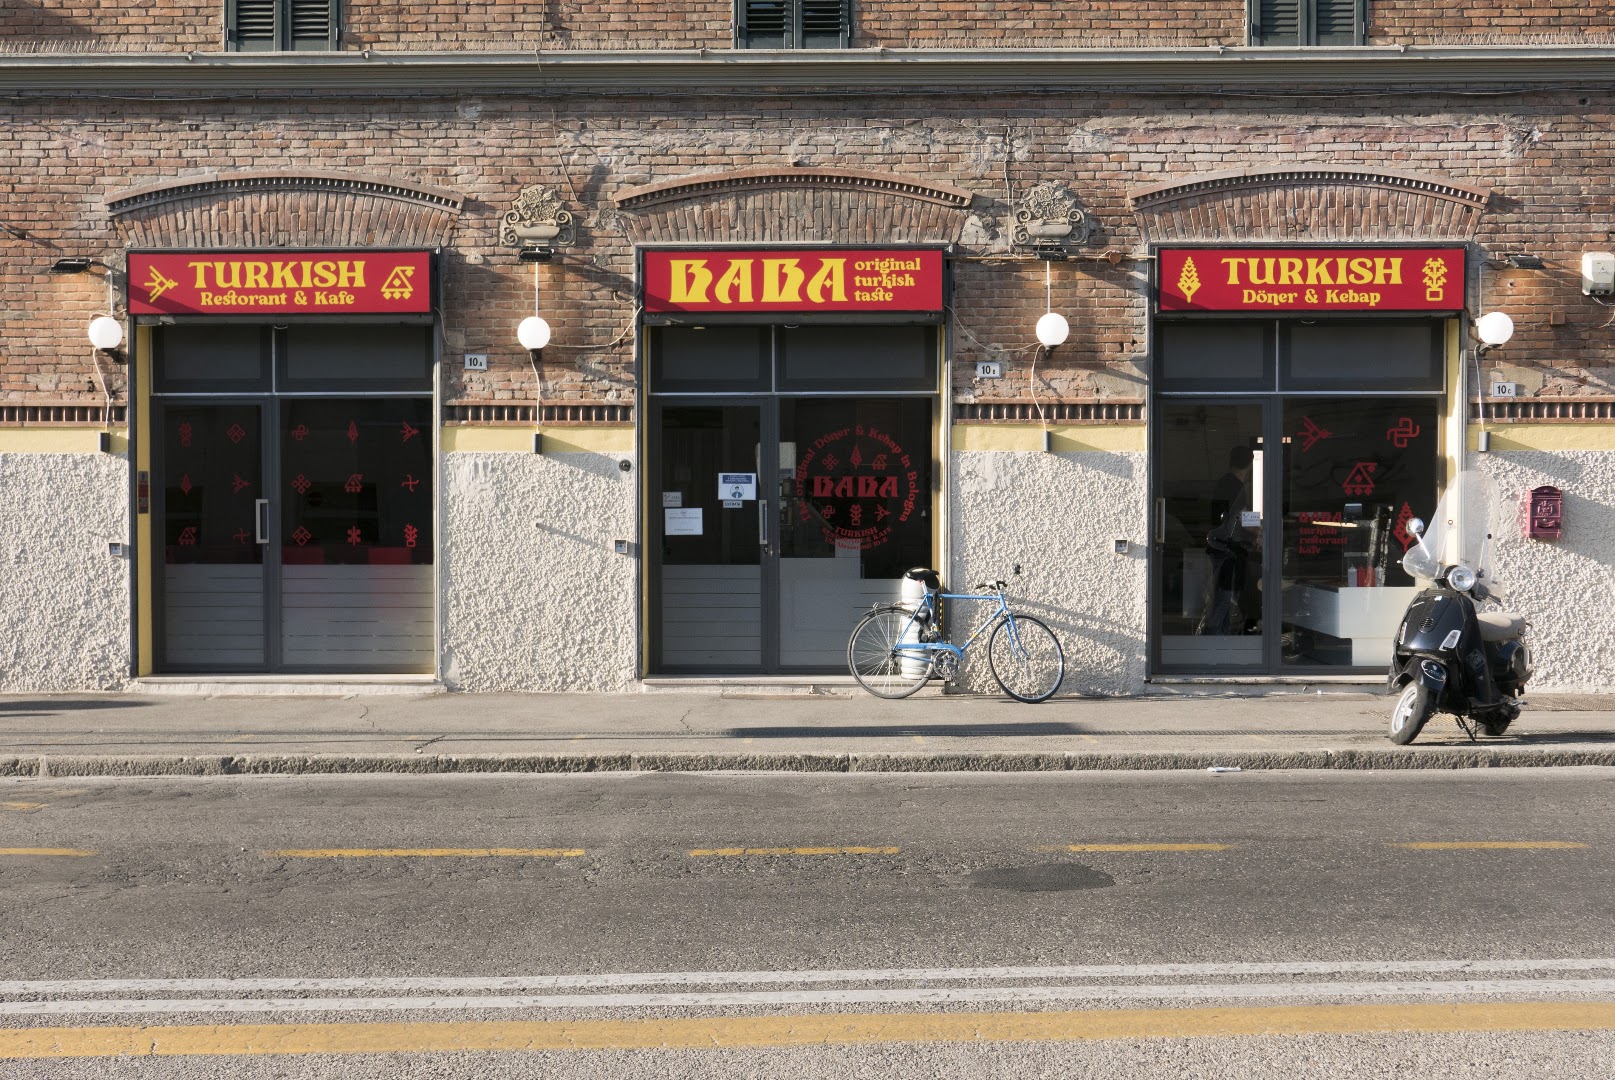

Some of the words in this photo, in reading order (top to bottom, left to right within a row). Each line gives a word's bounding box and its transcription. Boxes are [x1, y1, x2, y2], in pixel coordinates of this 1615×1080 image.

[855, 258, 920, 273] original
[1221, 258, 1402, 284] TURKISH
[188, 261, 366, 288] TURKISH
[669, 258, 848, 304] BABA
[854, 273, 915, 288] turkish
[201, 290, 287, 305] Restorant
[294, 291, 307, 305] &
[315, 291, 354, 304] Kafe
[854, 288, 893, 301] taste
[1243, 290, 1298, 305] Döner
[1305, 289, 1318, 303] &
[1326, 290, 1380, 306] Kebap
[855, 425, 864, 436] &
[815, 428, 850, 449] Döner
[868, 427, 902, 454] Kebap
[900, 454, 911, 468] in
[796, 448, 815, 496] original
[814, 476, 898, 497] BABA
[900, 471, 919, 521] Bologna
[835, 526, 878, 537] TURKISH
[872, 527, 892, 540] KAFE
[1299, 527, 1337, 536] turkish
[1299, 535, 1348, 545] restorant
[1298, 544, 1321, 554] kafe
